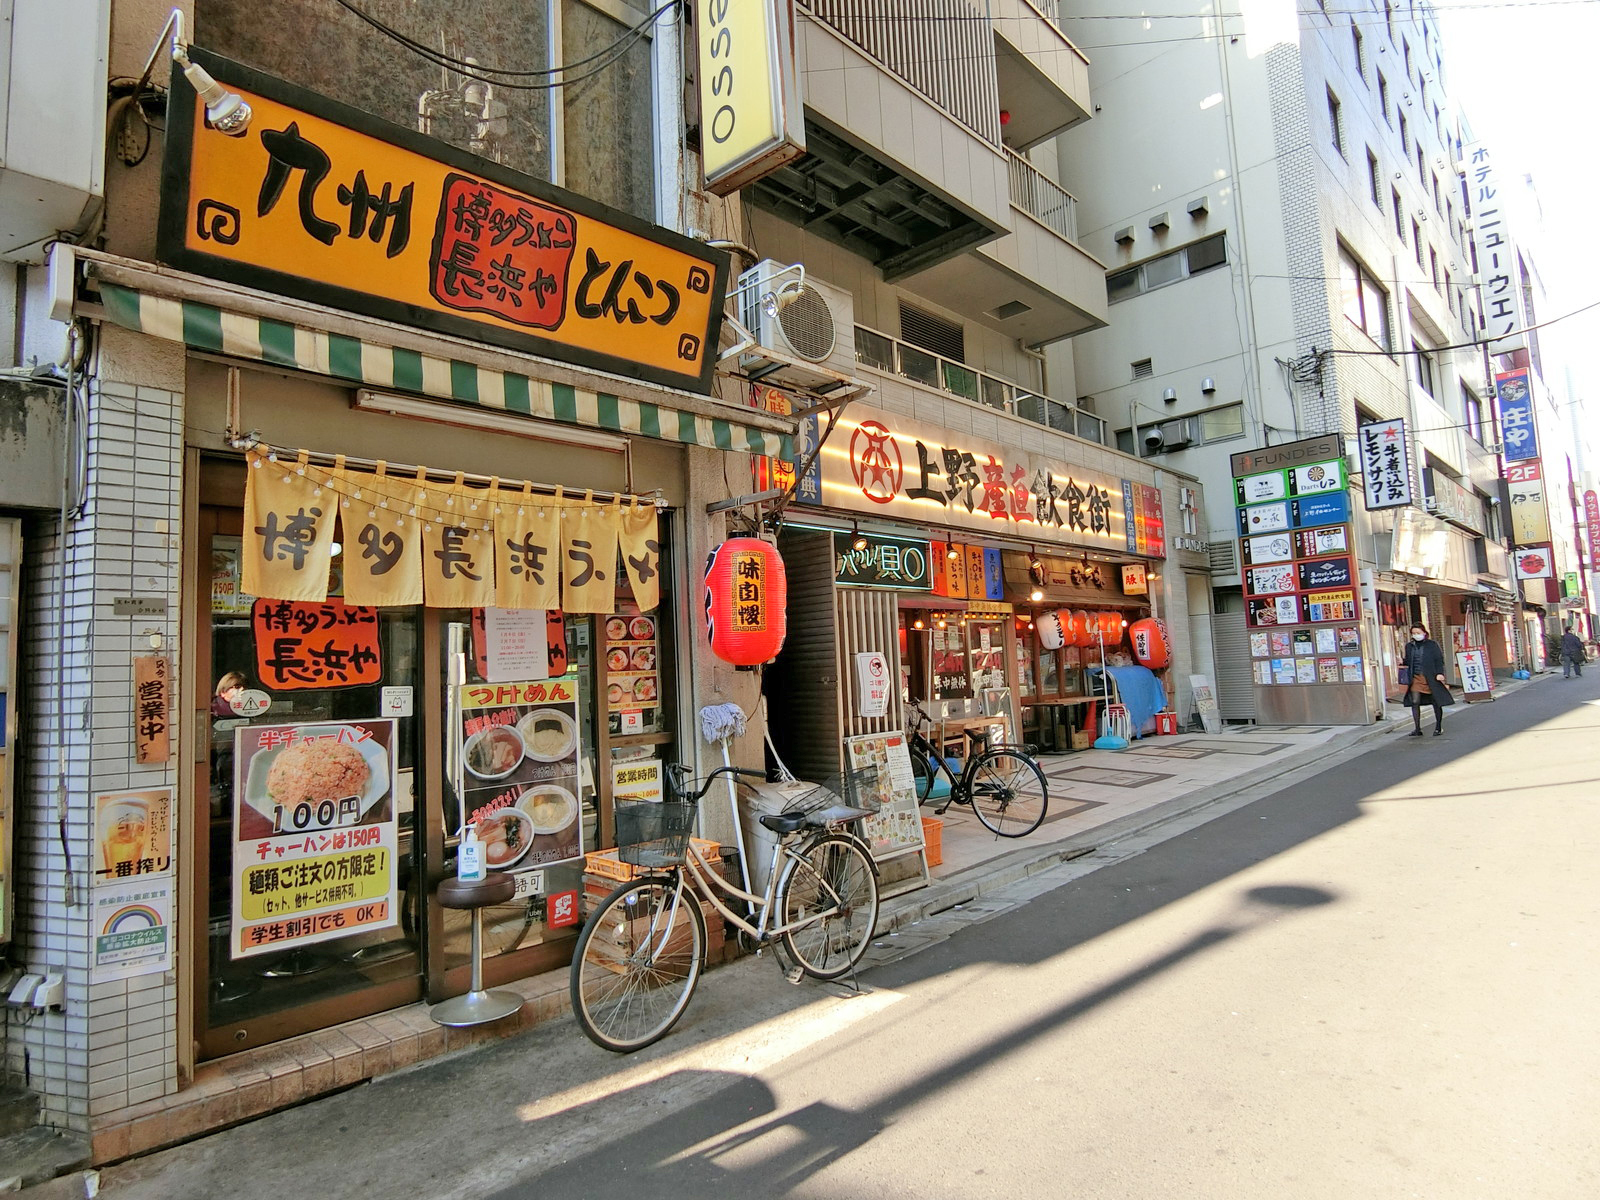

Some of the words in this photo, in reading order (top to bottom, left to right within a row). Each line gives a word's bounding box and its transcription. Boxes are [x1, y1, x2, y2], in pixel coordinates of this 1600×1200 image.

[257, 120, 415, 259] 九州
[452, 190, 572, 249] 博多ラーメン
[1472, 147, 1515, 343] ホテルニューウエノ
[441, 239, 558, 309] 長浜や
[575, 247, 681, 326] とんこつ
[1501, 407, 1529, 447] 庄や
[1254, 443, 1331, 467] FUNDES
[1364, 429, 1383, 504] レモンサワー
[1384, 444, 1405, 500] 牛煮込み
[1510, 466, 1535, 480] 2F
[1292, 502, 1298, 516] 7F
[254, 507, 660, 588] 博多長浜ラーメ
[1244, 540, 1249, 554] 6F
[214, 583, 234, 594] 250円
[738, 557, 760, 626] 味自慢
[1255, 573, 1280, 584] テング
[156, 660, 165, 677] 只今
[265, 638, 378, 683] 長浜や
[139, 680, 165, 741] 営業中
[468, 684, 571, 705] つけめん
[140, 743, 148, 760] です
[258, 726, 374, 752] 半チャーハン
[617, 768, 657, 784] 営業時間
[272, 796, 363, 833] 100円
[256, 826, 381, 860] チャーハンは150円
[96, 856, 170, 877] 一番搾り
[249, 852, 385, 895] 麺類ご注文の方限定!
[100, 890, 166, 906] 感染防止徹底宣言
[102, 929, 162, 944] 新型コロナウイルス
[107, 936, 158, 950] 感染拡大防止中
[251, 912, 346, 944] 学生割引でも
